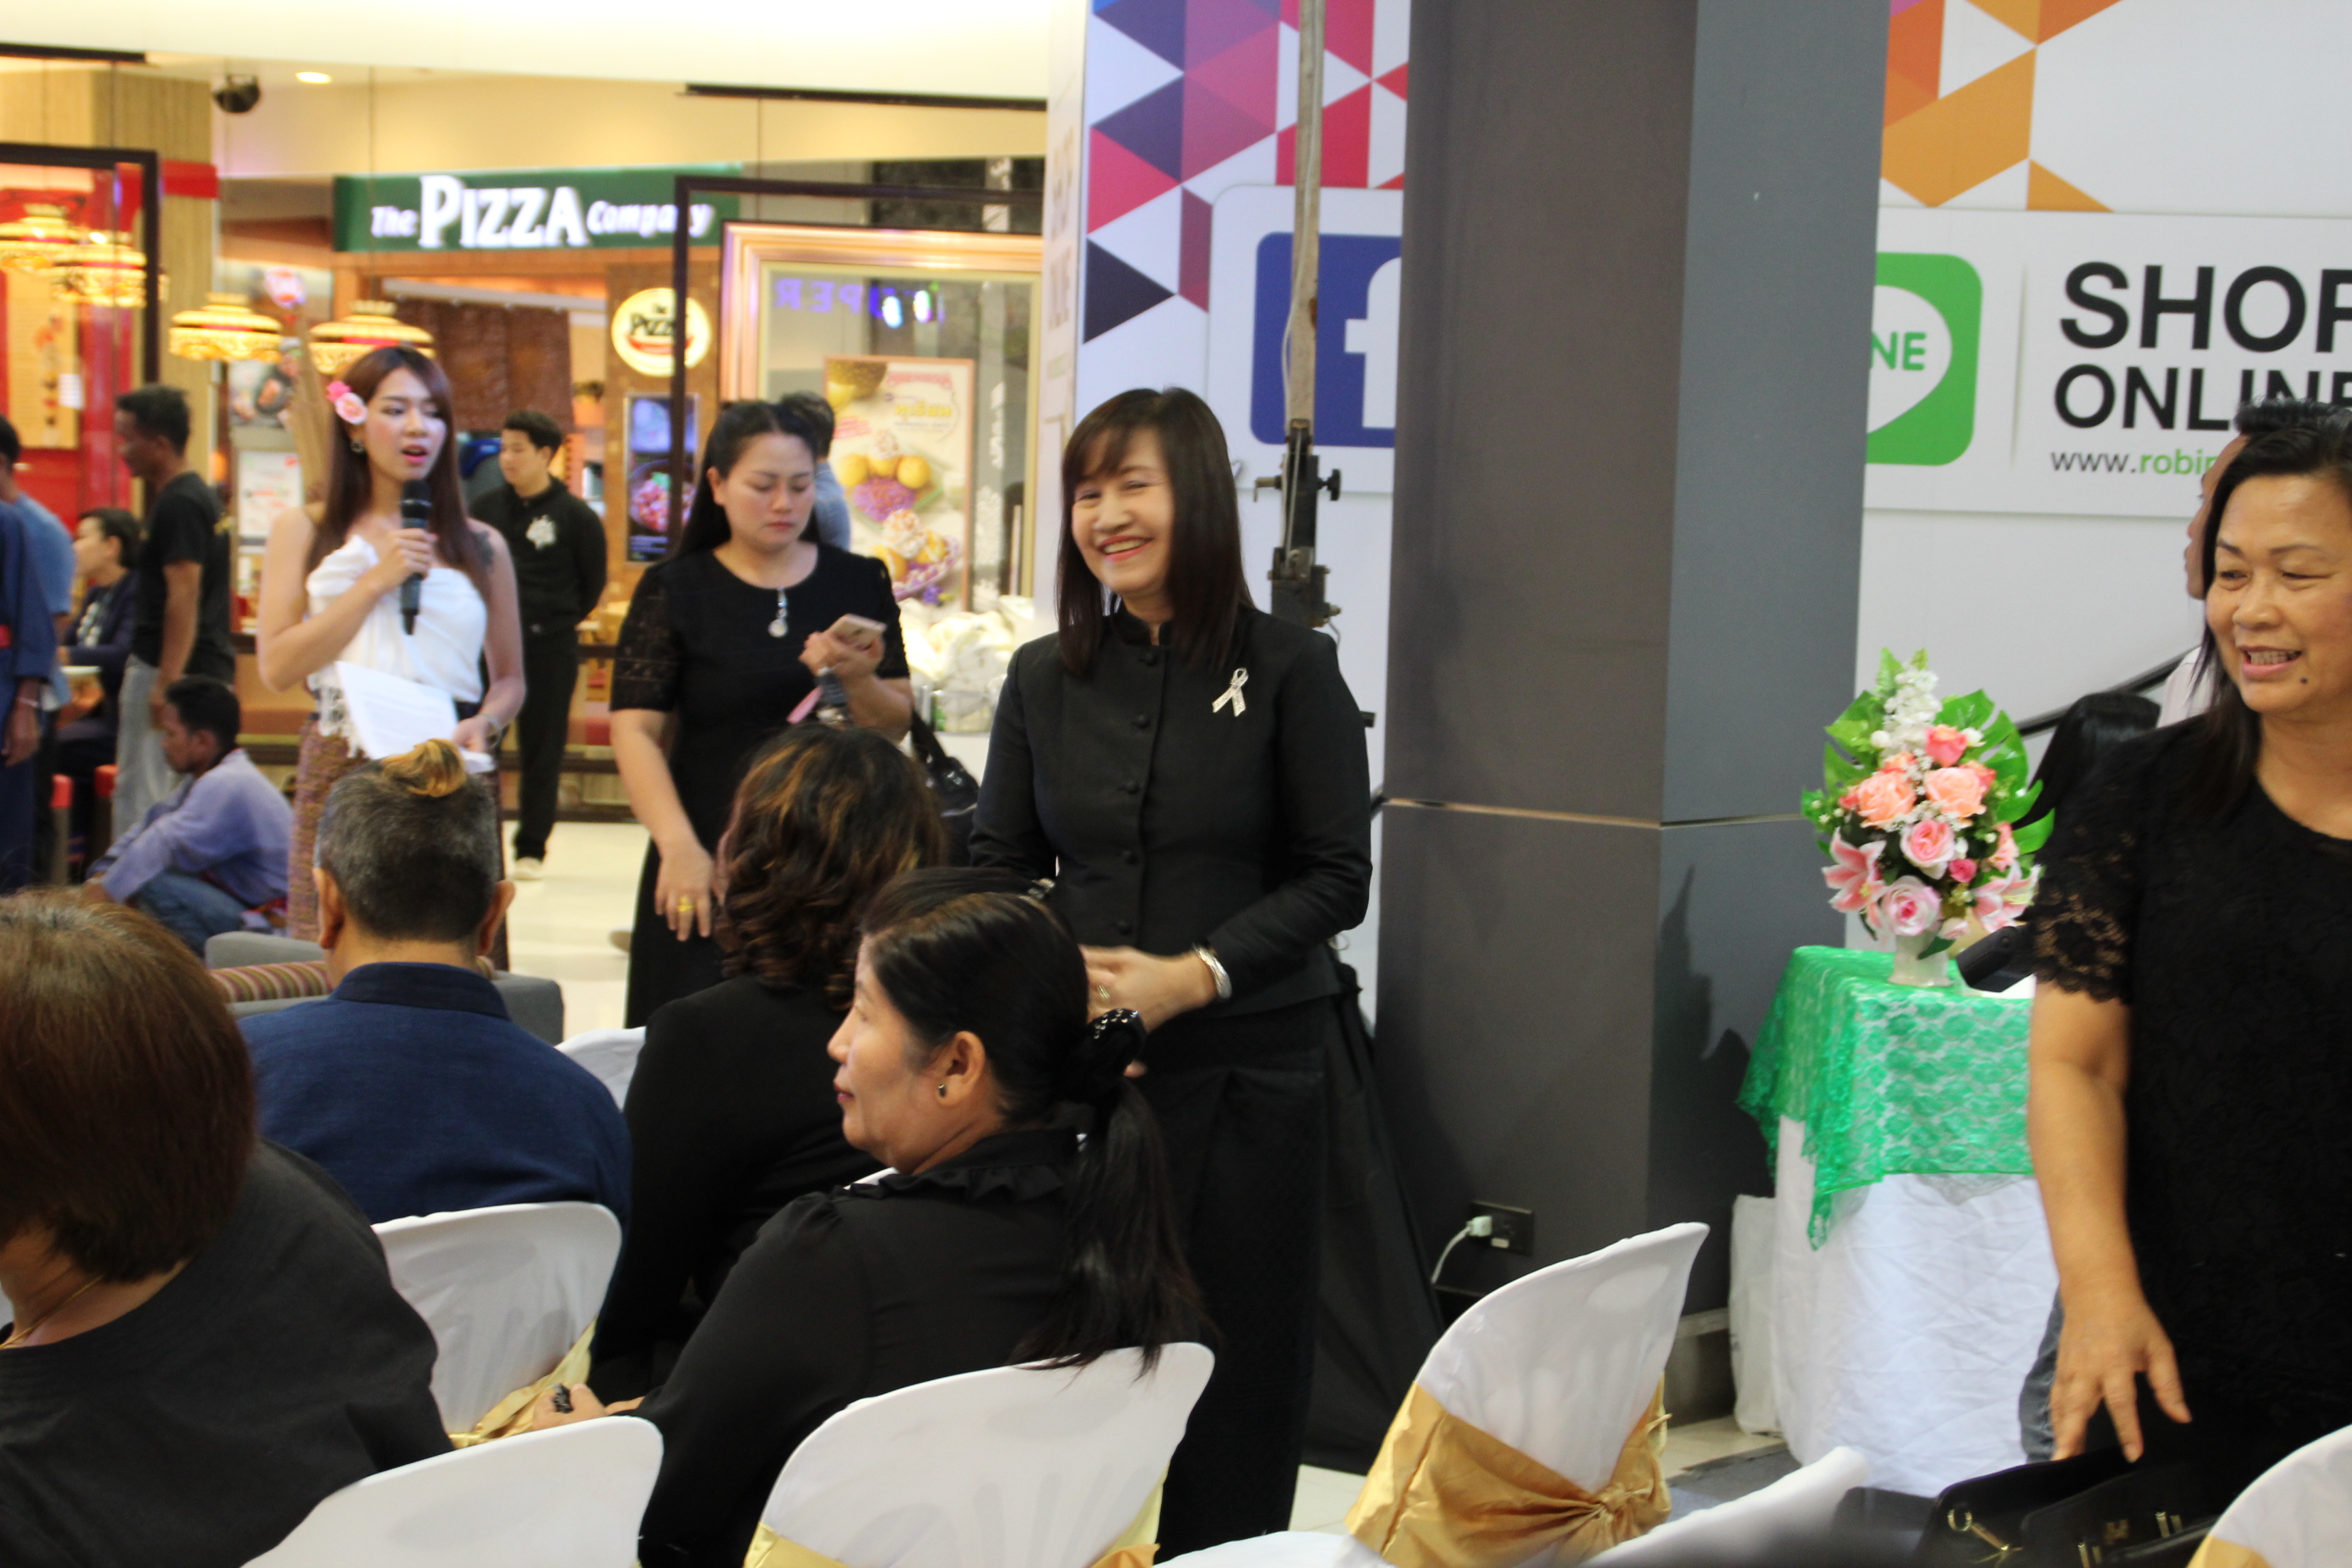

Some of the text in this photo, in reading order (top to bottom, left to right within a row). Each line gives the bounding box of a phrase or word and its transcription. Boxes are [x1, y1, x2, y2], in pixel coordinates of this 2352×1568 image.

[372, 174, 713, 248] The PIZZA Compay
[2059, 261, 2352, 353] SHOP
